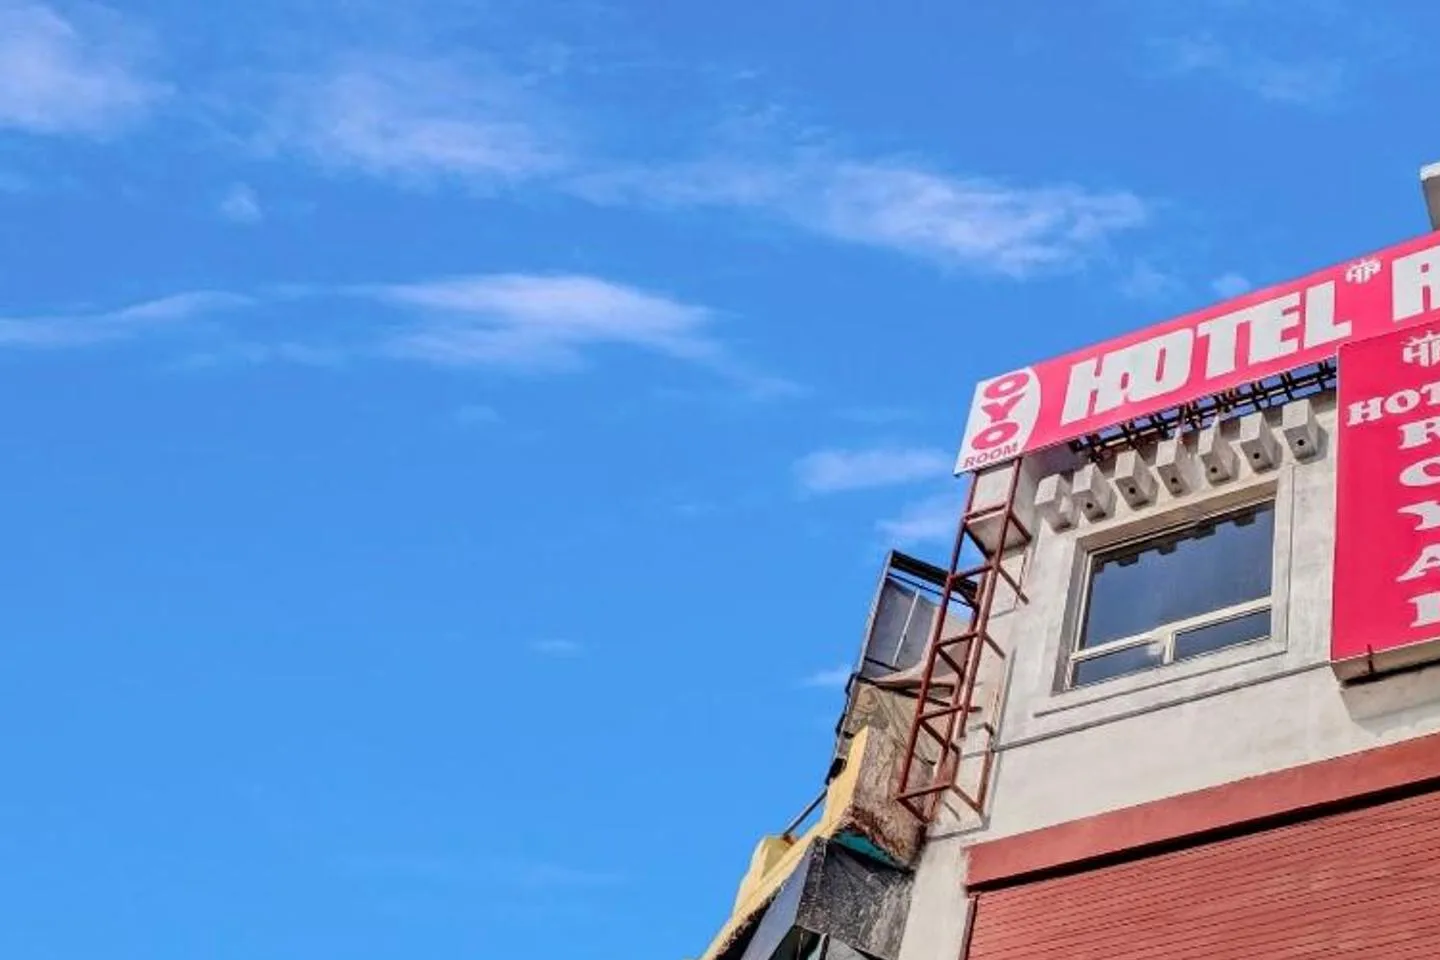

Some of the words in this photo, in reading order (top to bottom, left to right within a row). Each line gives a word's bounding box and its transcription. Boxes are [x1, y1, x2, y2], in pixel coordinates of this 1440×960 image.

[1061, 281, 1352, 426] HOTEL
[971, 371, 1030, 451] OYO
[962, 440, 1019, 469] ROOM
